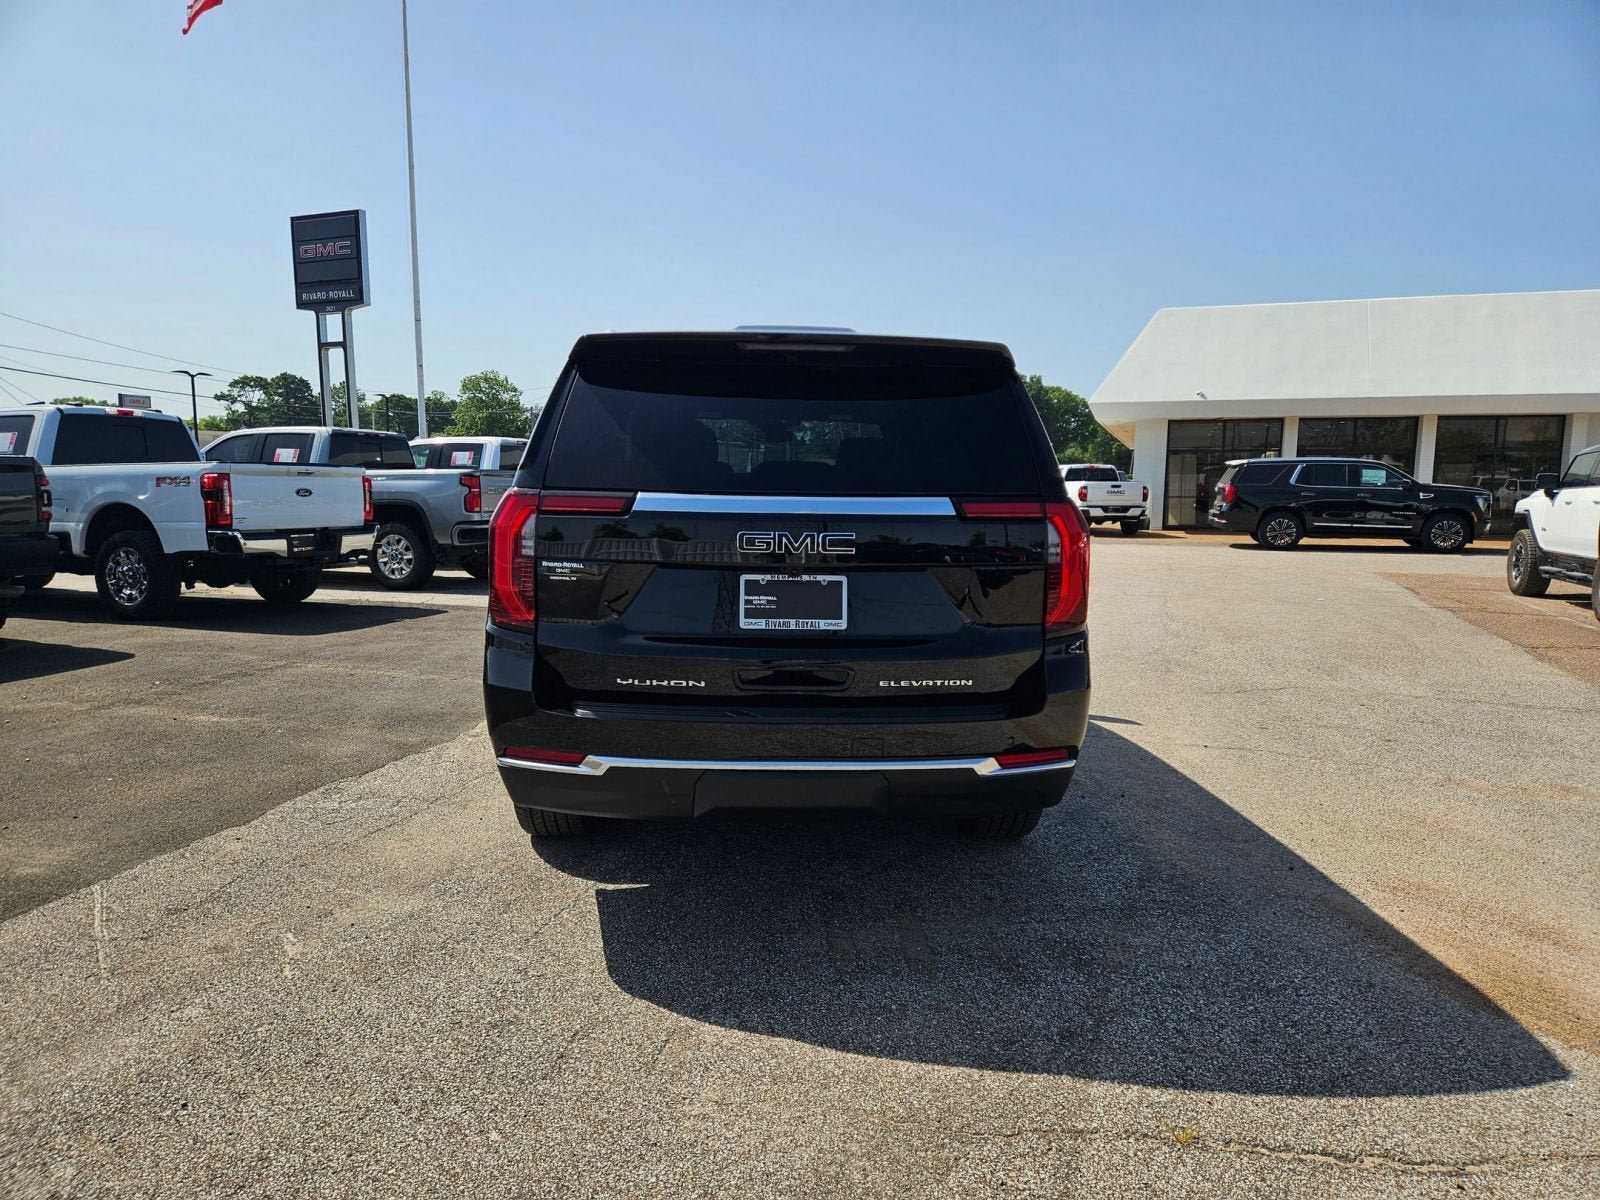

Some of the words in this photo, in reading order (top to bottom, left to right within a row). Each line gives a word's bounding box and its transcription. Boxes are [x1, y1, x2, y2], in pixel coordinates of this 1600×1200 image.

[300, 241, 351, 258] GMC
[737, 531, 855, 554] GMC
[616, 678, 706, 687] YUKON
[879, 679, 973, 687] ELEVATION
